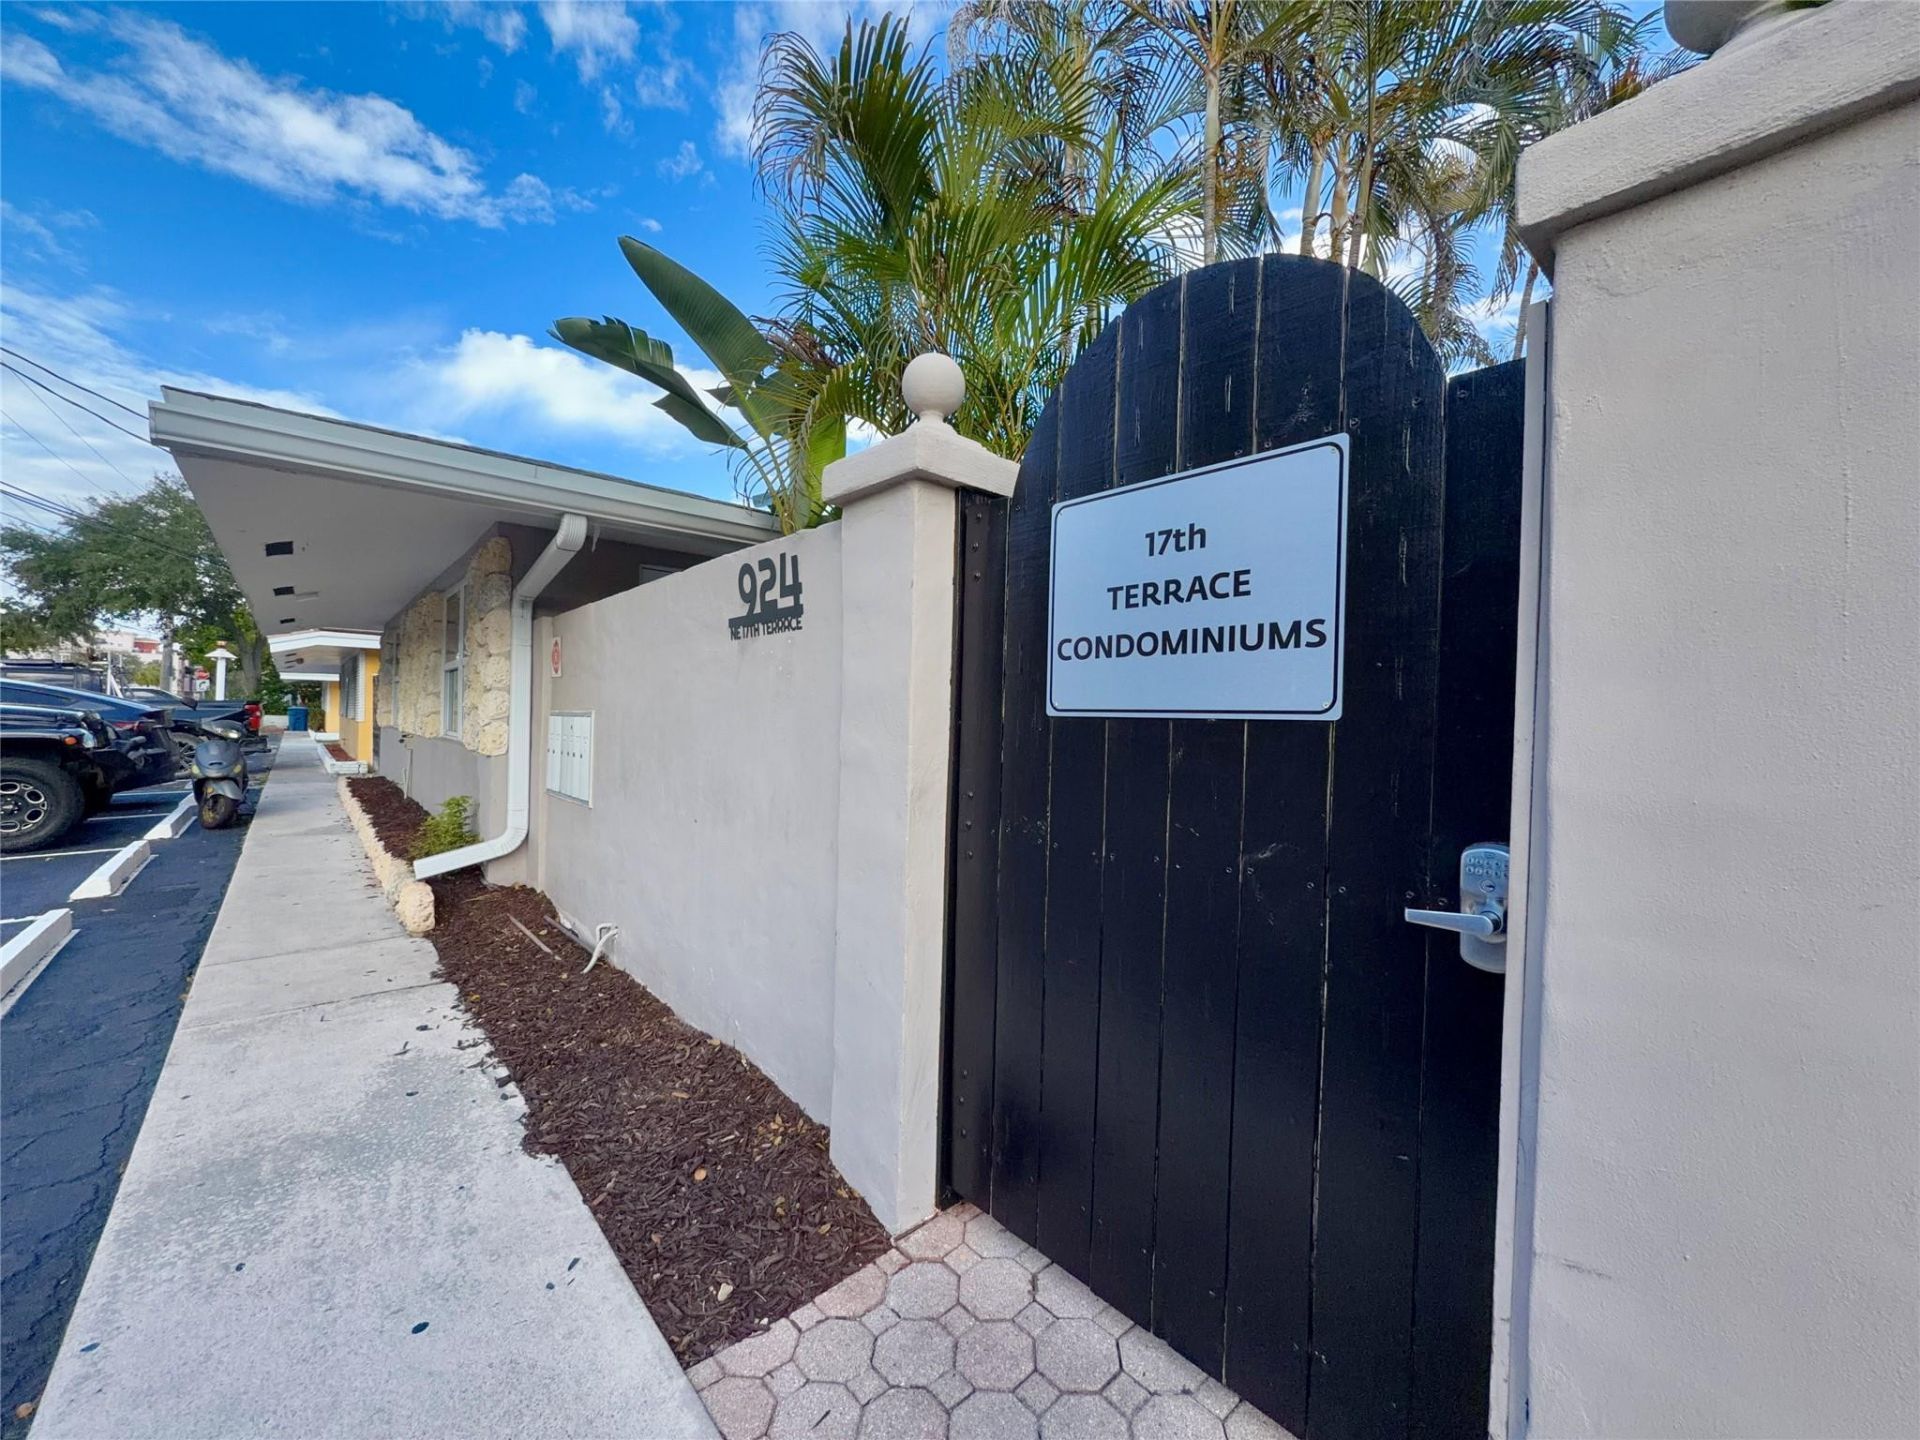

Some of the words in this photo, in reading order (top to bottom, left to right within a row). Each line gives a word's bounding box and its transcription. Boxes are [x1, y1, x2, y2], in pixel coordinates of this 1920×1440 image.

[1145, 523, 1207, 557] 17th
[738, 552, 803, 616] 924
[1107, 569, 1251, 610] TERRACE
[730, 625, 741, 641] NE
[762, 616, 803, 636] TERRACE
[1057, 618, 1327, 661] CONDOMINIUMS
